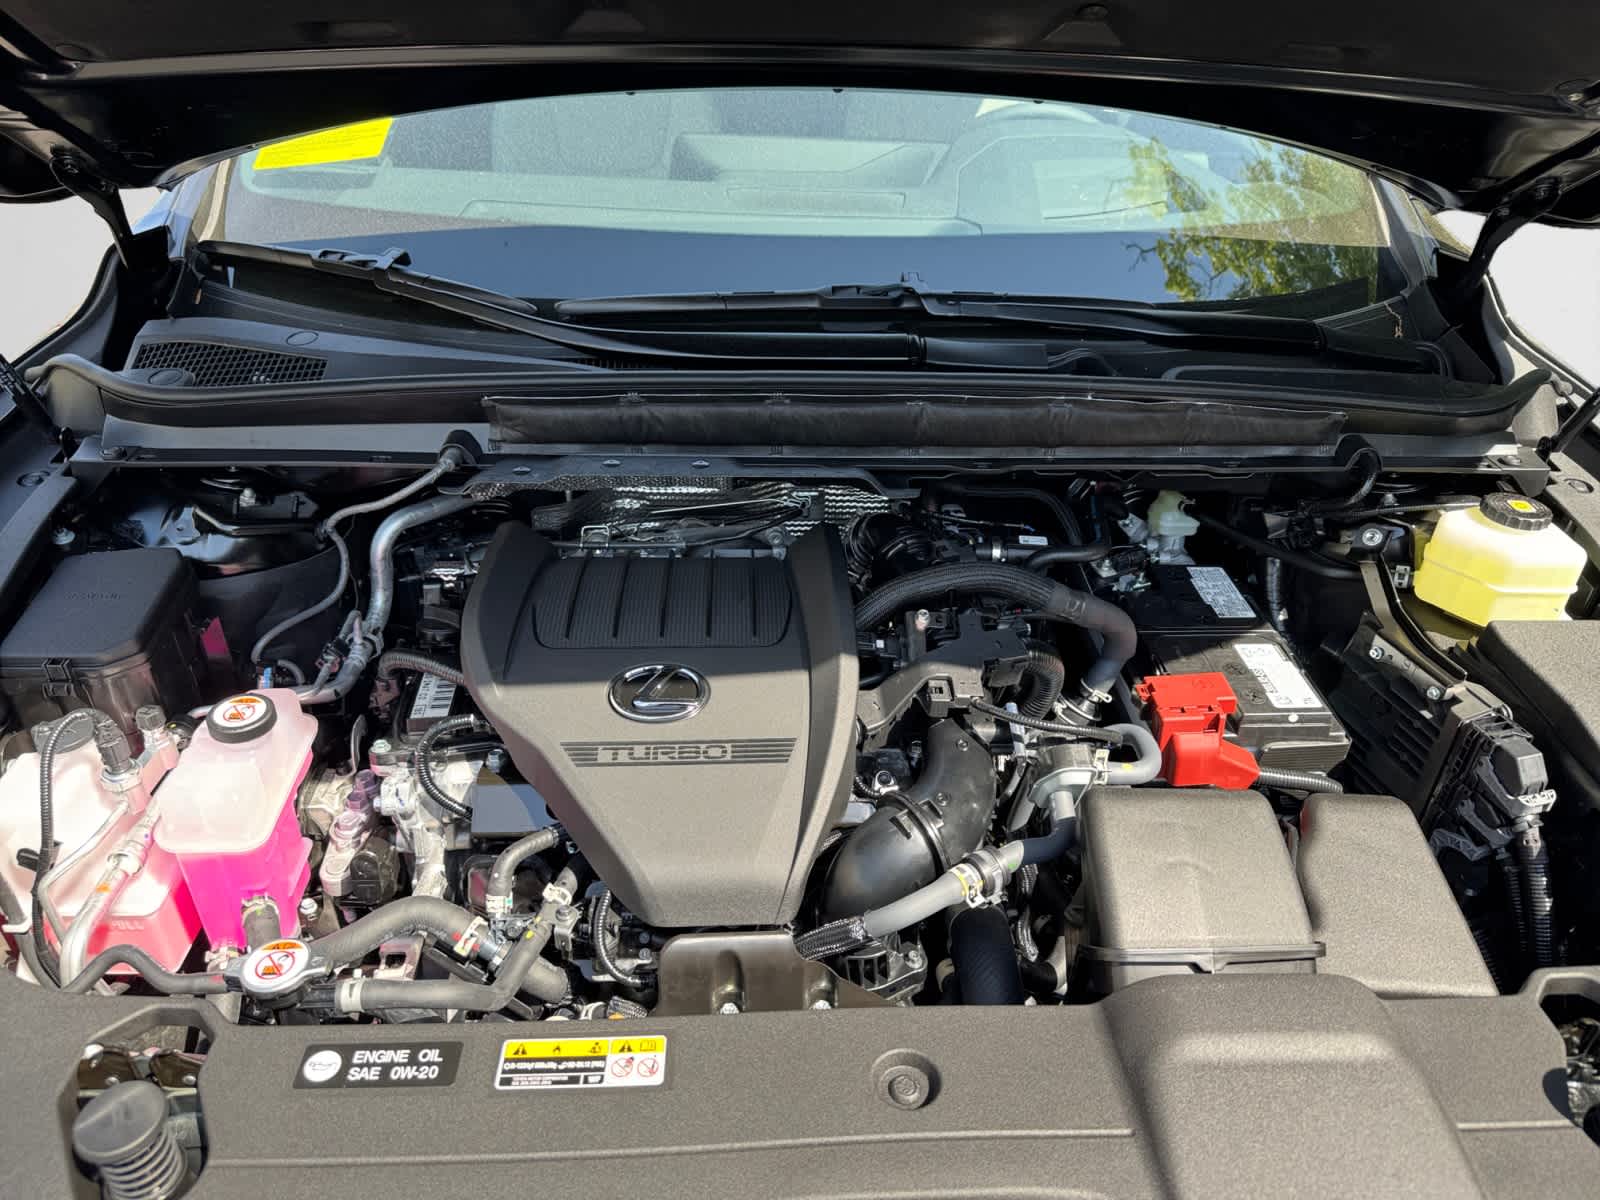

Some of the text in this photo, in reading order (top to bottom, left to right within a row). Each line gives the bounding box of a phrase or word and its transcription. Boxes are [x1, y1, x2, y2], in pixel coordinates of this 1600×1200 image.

[602, 744, 728, 761] TURBO
[352, 1048, 443, 1064] ENGINE OIL
[347, 1065, 439, 1081] SAE 0W-20
